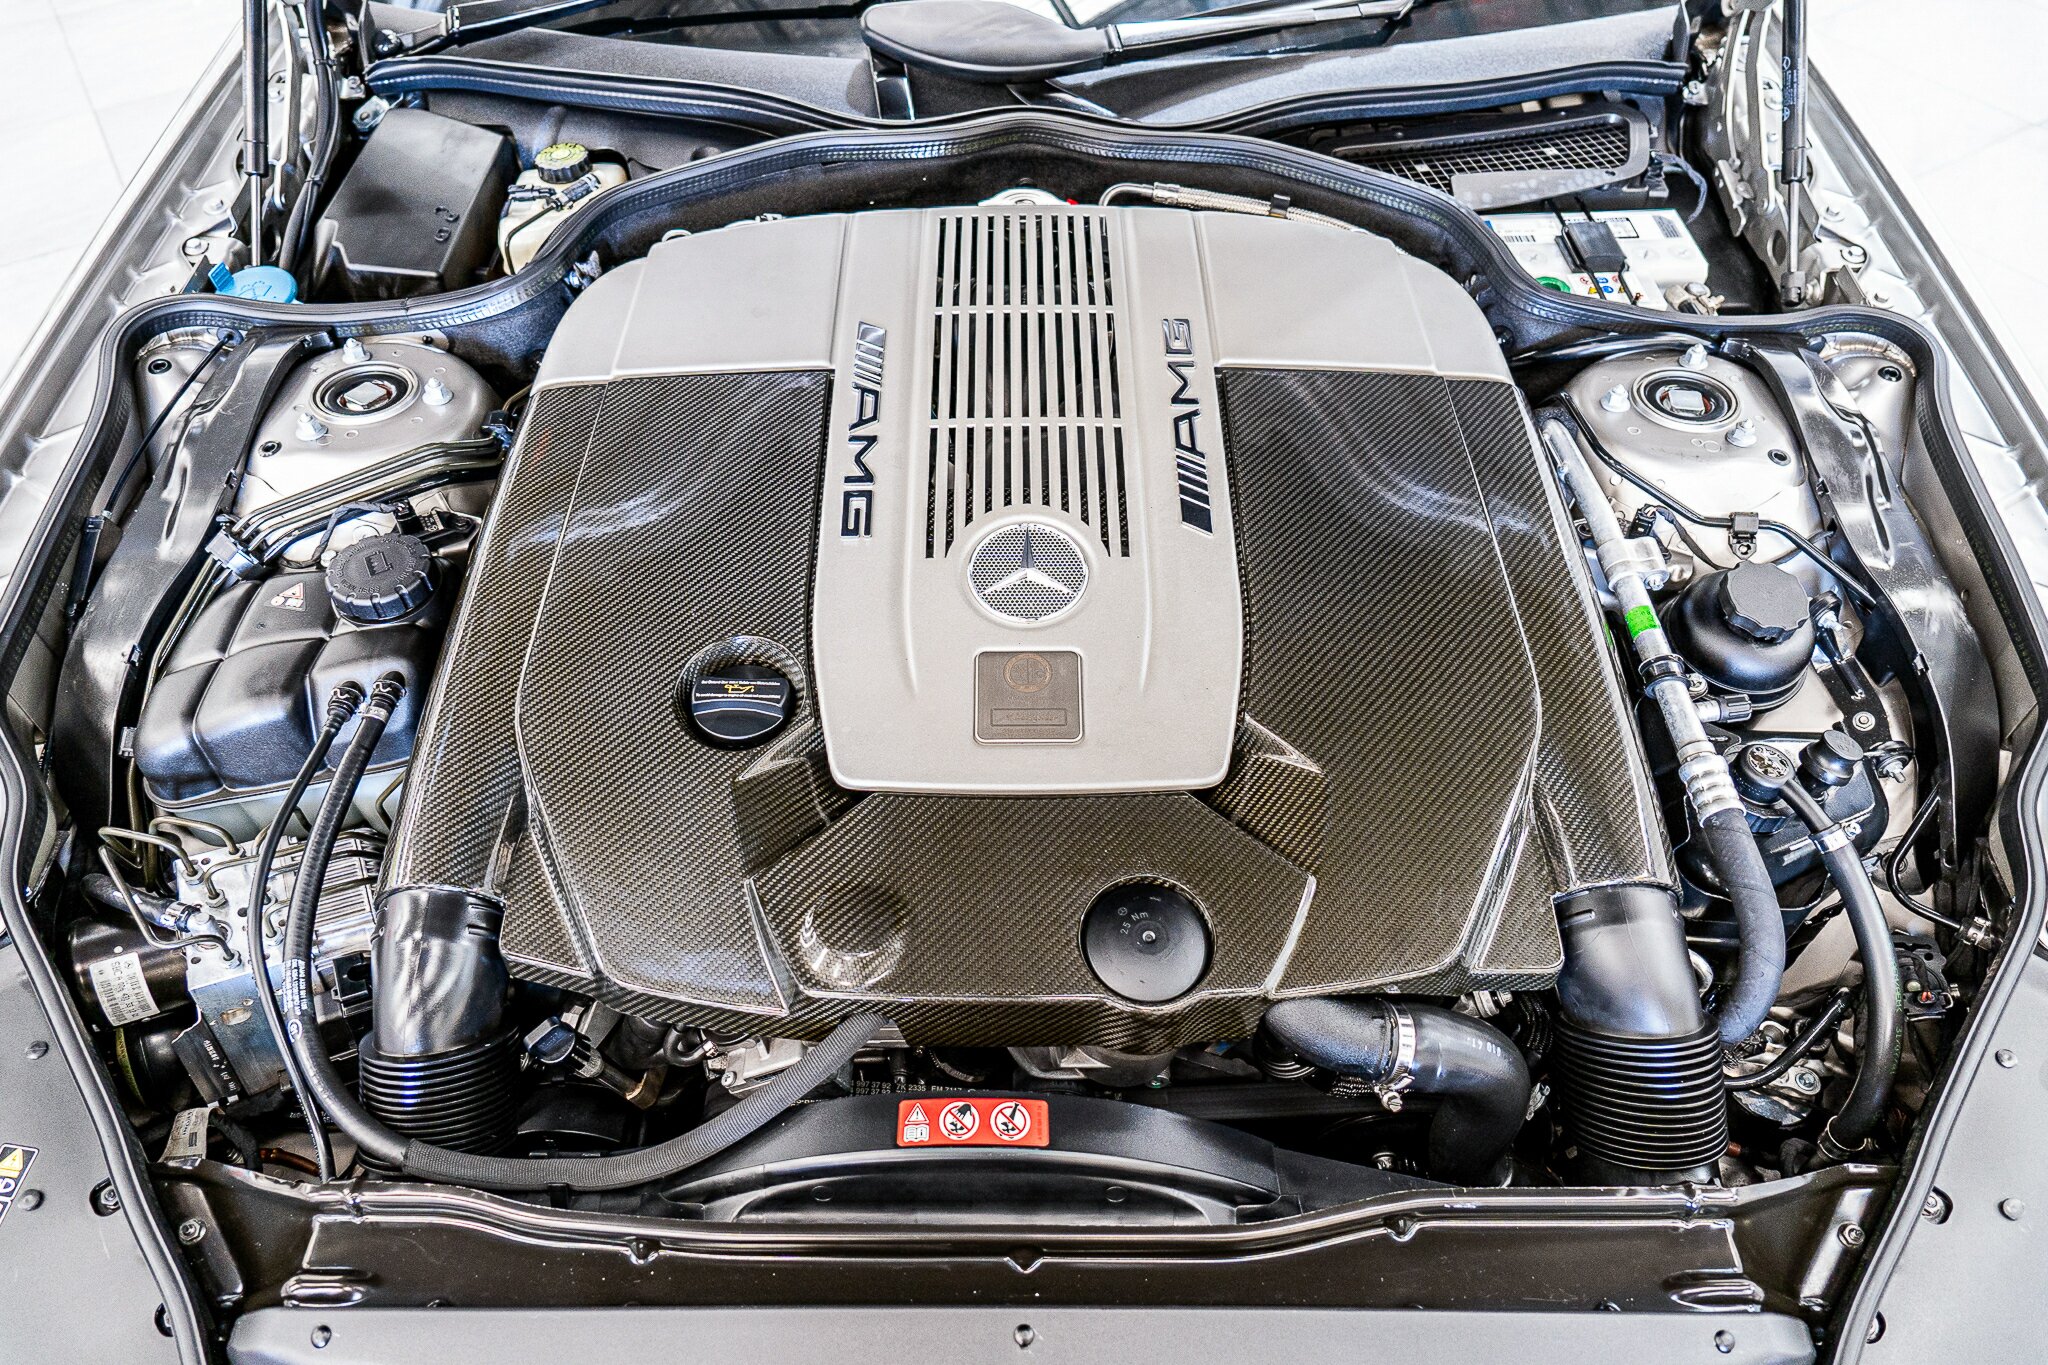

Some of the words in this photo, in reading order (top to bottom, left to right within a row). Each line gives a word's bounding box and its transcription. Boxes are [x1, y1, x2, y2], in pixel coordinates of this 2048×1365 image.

[1162, 318, 1207, 460] AMG
[840, 381, 881, 539] AMG
[1120, 921, 1132, 935] 25
[1131, 911, 1149, 921] Nm
[908, 1084, 927, 1092] 2335
